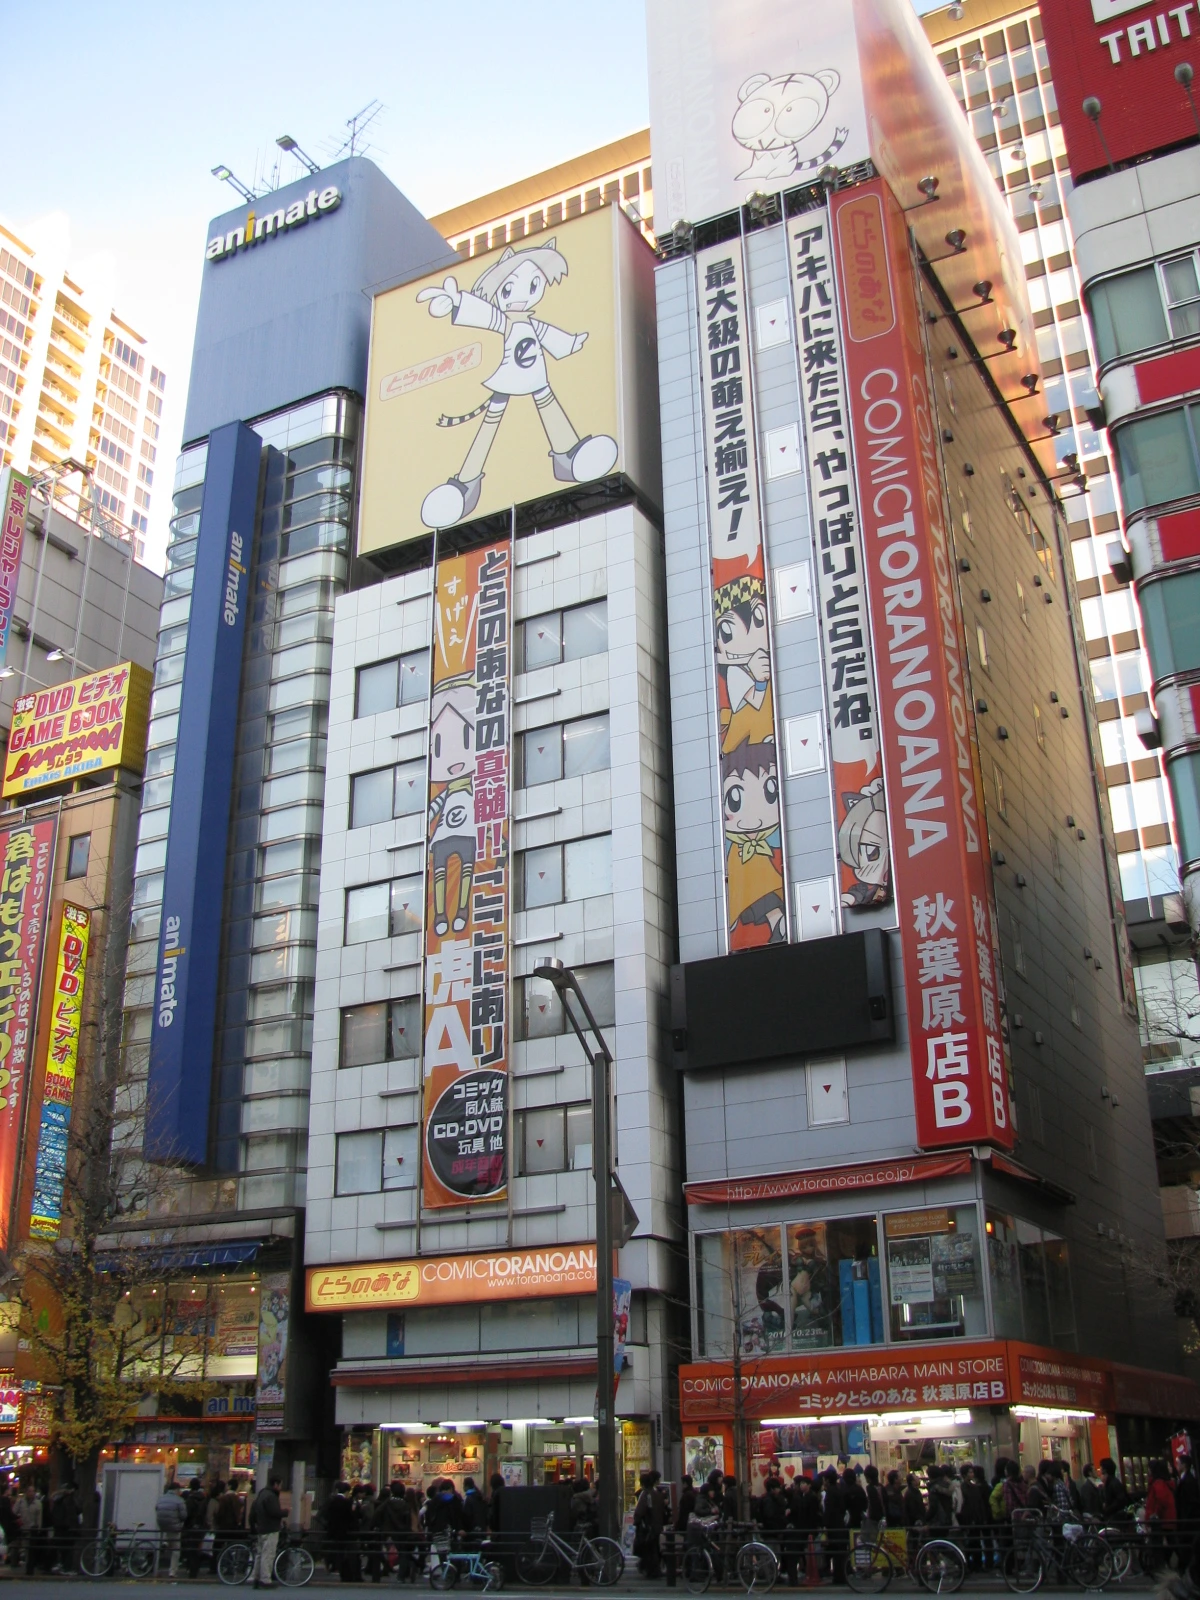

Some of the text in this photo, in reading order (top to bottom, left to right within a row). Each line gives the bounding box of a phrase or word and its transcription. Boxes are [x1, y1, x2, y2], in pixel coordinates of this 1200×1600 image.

[1099, 0, 1200, 64] TAIT
[206, 184, 341, 261] animate
[850, 209, 887, 323] とらのあな
[386, 347, 475, 392] とらのあな
[224, 531, 247, 626] animate
[34, 685, 75, 720] DVD
[78, 669, 128, 704] ビデオ
[9, 696, 126, 753] GAME BOOK
[158, 915, 187, 1028] animate
[912, 891, 971, 1129] 秋葉原店B
[971, 894, 1006, 1130] 秋葉原店B
[453, 1079, 503, 1099] コミック
[465, 1097, 503, 1117] 同人誌
[458, 1134, 503, 1155] 玩具 他
[317, 1271, 411, 1296] とらのあな
[422, 1250, 597, 1282] COMICTORANOAN
[799, 1381, 1004, 1408] コミックとらのあな 秋葉原店B
[826, 1365, 909, 1384] AKIHABARA
[914, 1362, 953, 1378] MAIN
[958, 1357, 1004, 1375] STORE
